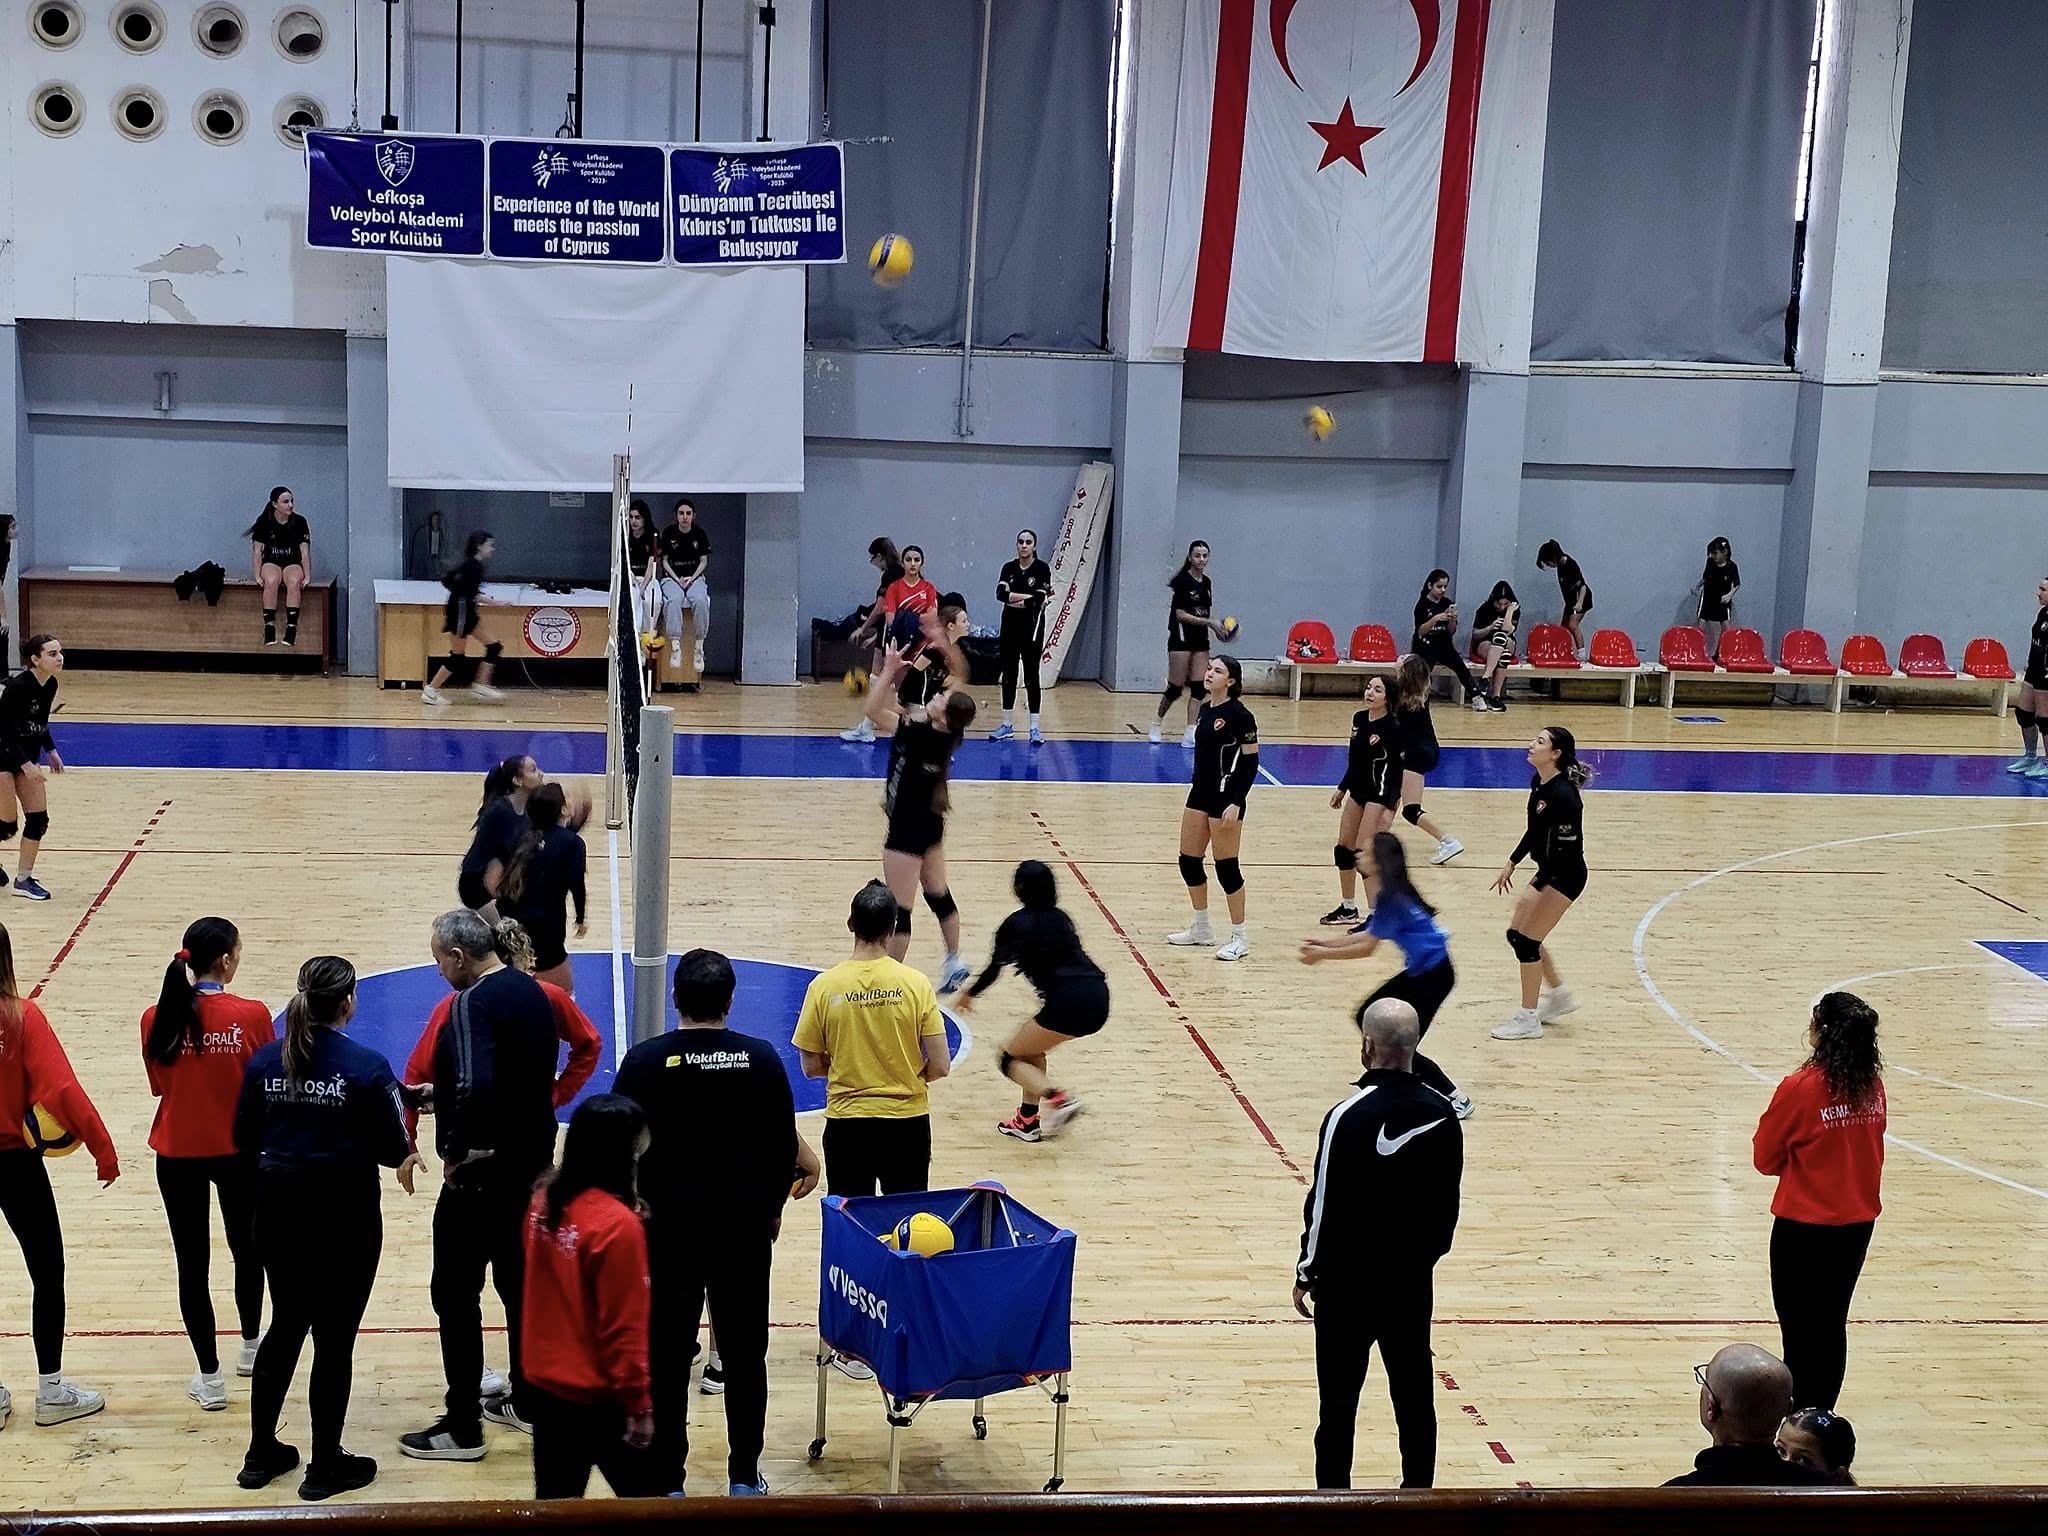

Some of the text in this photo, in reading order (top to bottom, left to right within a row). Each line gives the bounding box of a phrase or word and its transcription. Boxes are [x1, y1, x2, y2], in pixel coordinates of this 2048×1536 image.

[367, 189, 425, 208] Lefkoşa
[493, 195, 660, 217] Experience of the World
[679, 191, 835, 214] Dünyanın Tecrübesi
[330, 206, 464, 228] Voleybol Akademi
[750, 215, 811, 234] Tutkusu
[816, 210, 837, 232] İle
[351, 228, 443, 247] Spor Kulübü
[513, 218, 640, 237] meets the passion
[544, 237, 610, 256] of Cyprus
[719, 239, 799, 259] Buluşuyor
[203, 1032, 233, 1046] ORAL
[264, 1078, 337, 1098] LEFOŞA
